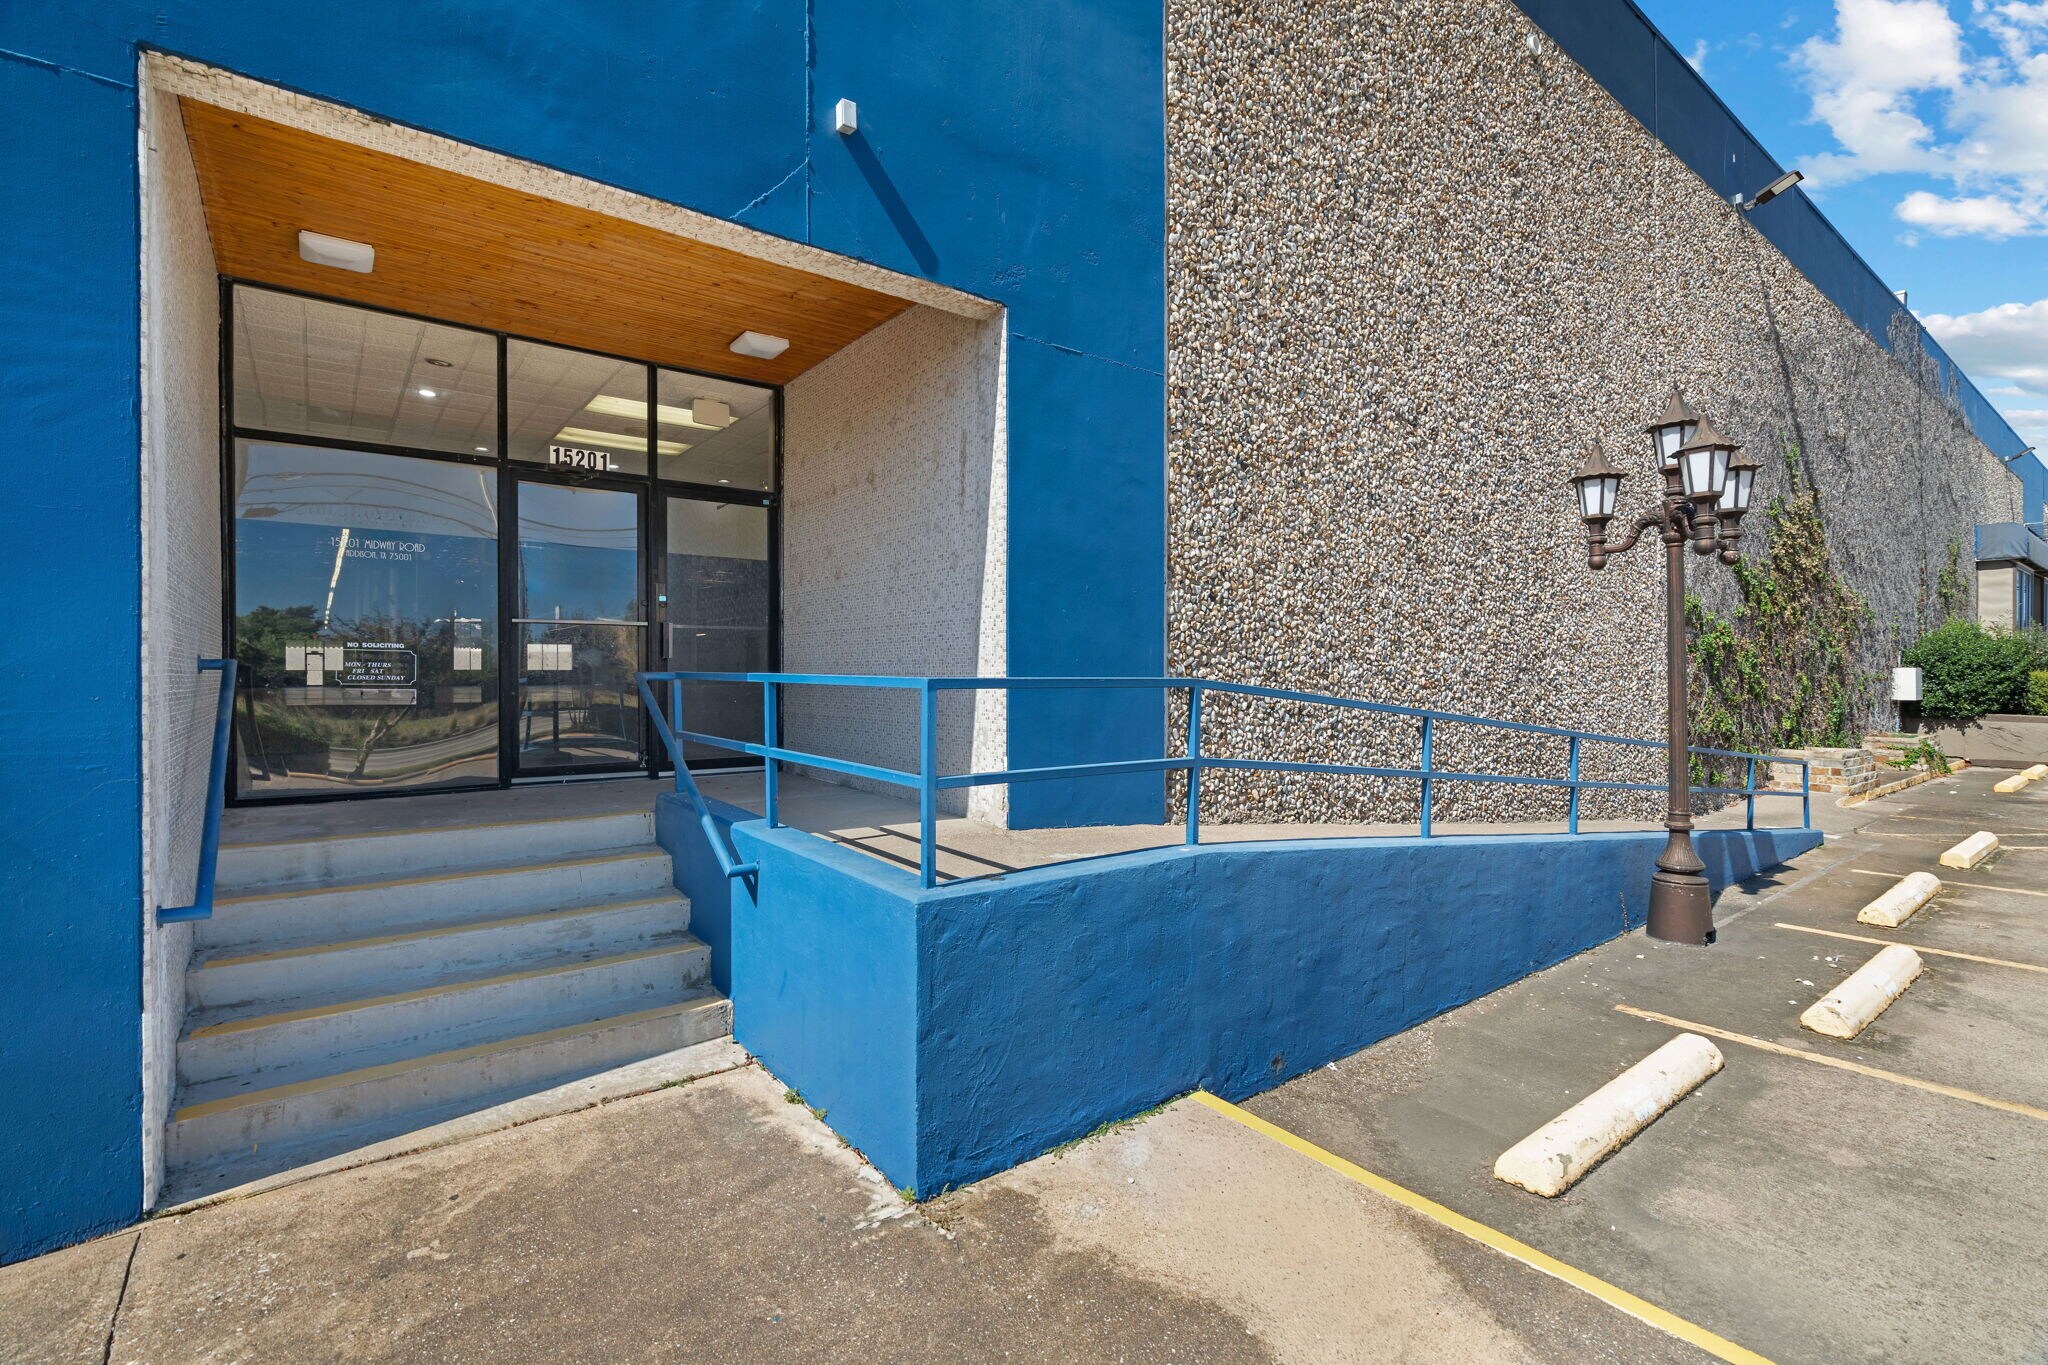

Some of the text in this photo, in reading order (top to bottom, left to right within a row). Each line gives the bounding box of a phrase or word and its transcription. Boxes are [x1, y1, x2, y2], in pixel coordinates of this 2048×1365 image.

[552, 447, 608, 471] 15201
[330, 537, 425, 553] 1501 MIDWAY ROAD
[380, 552, 387, 560] TX
[389, 552, 412, 561] 75001
